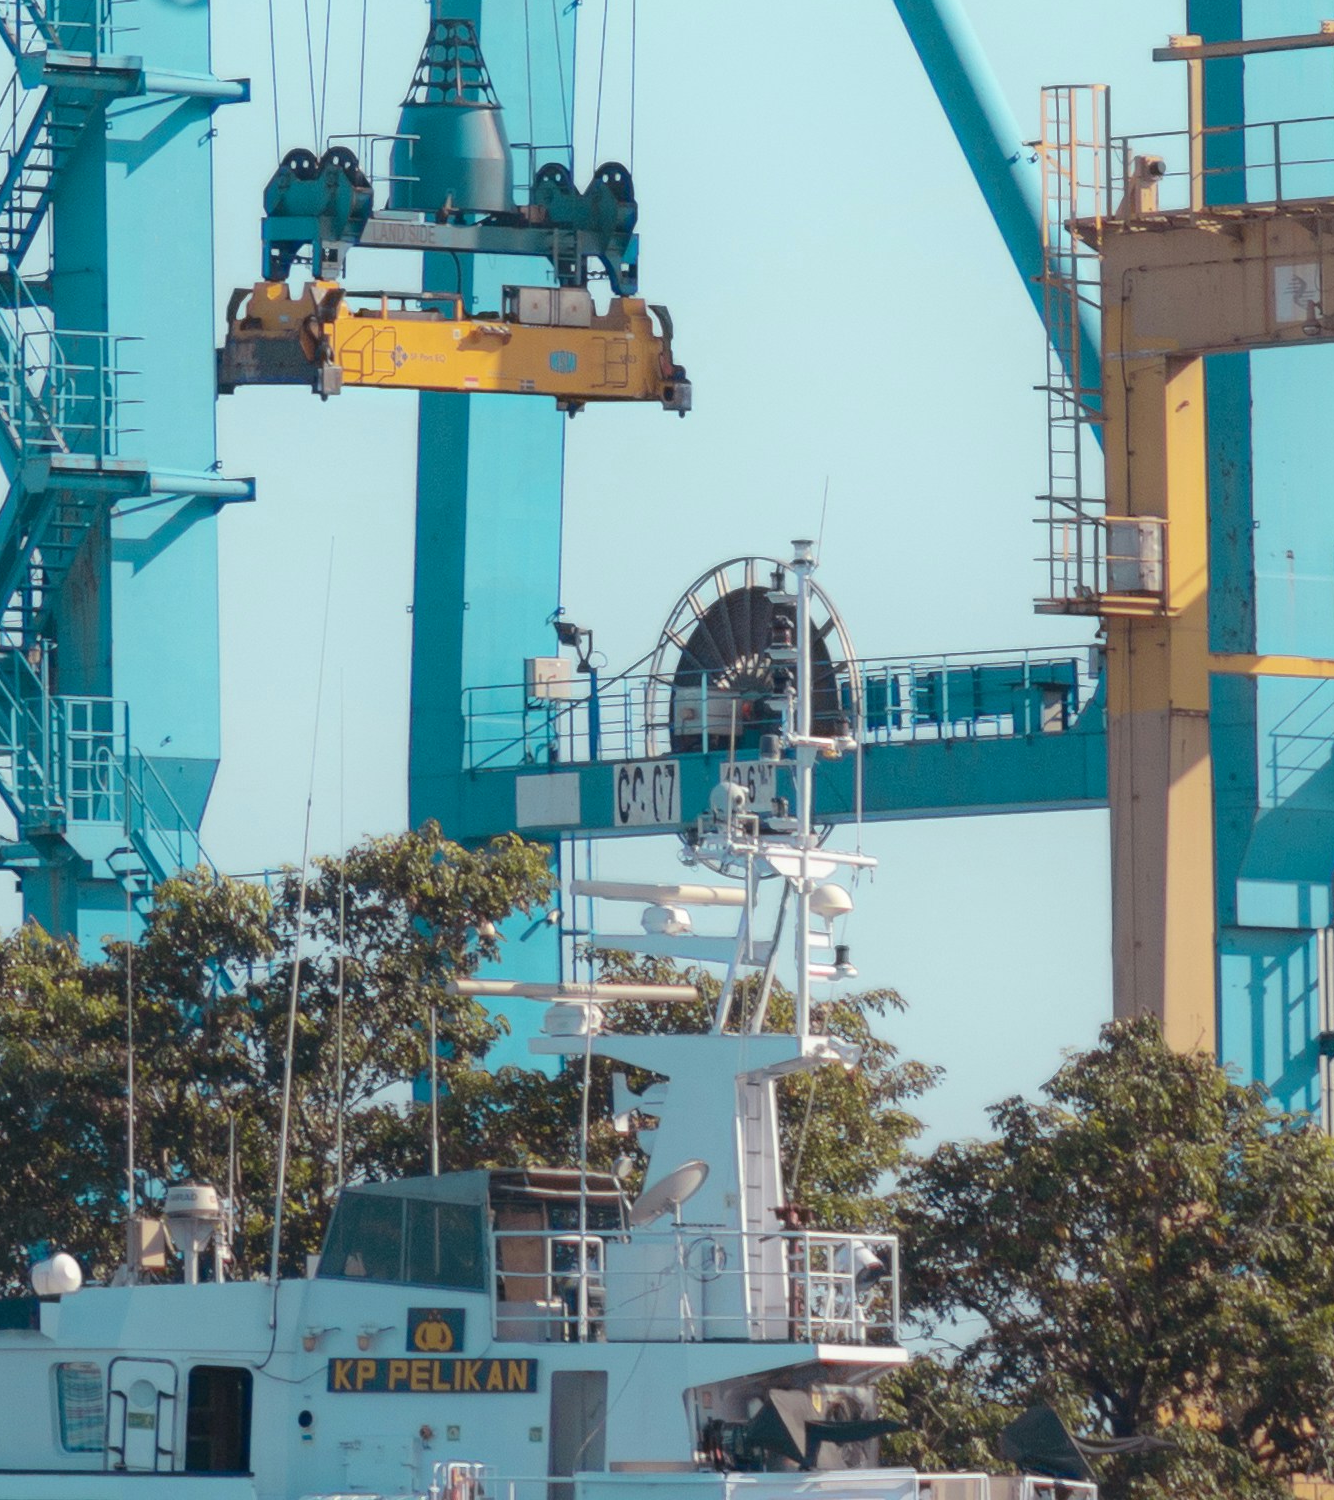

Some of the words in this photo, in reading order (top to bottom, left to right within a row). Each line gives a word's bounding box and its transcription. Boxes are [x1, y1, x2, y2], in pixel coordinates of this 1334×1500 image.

[372, 222, 406, 242] LAND
[409, 224, 436, 244] SIDE
[334, 1359, 376, 1391] KP
[388, 1359, 528, 1391] PELIKAN
